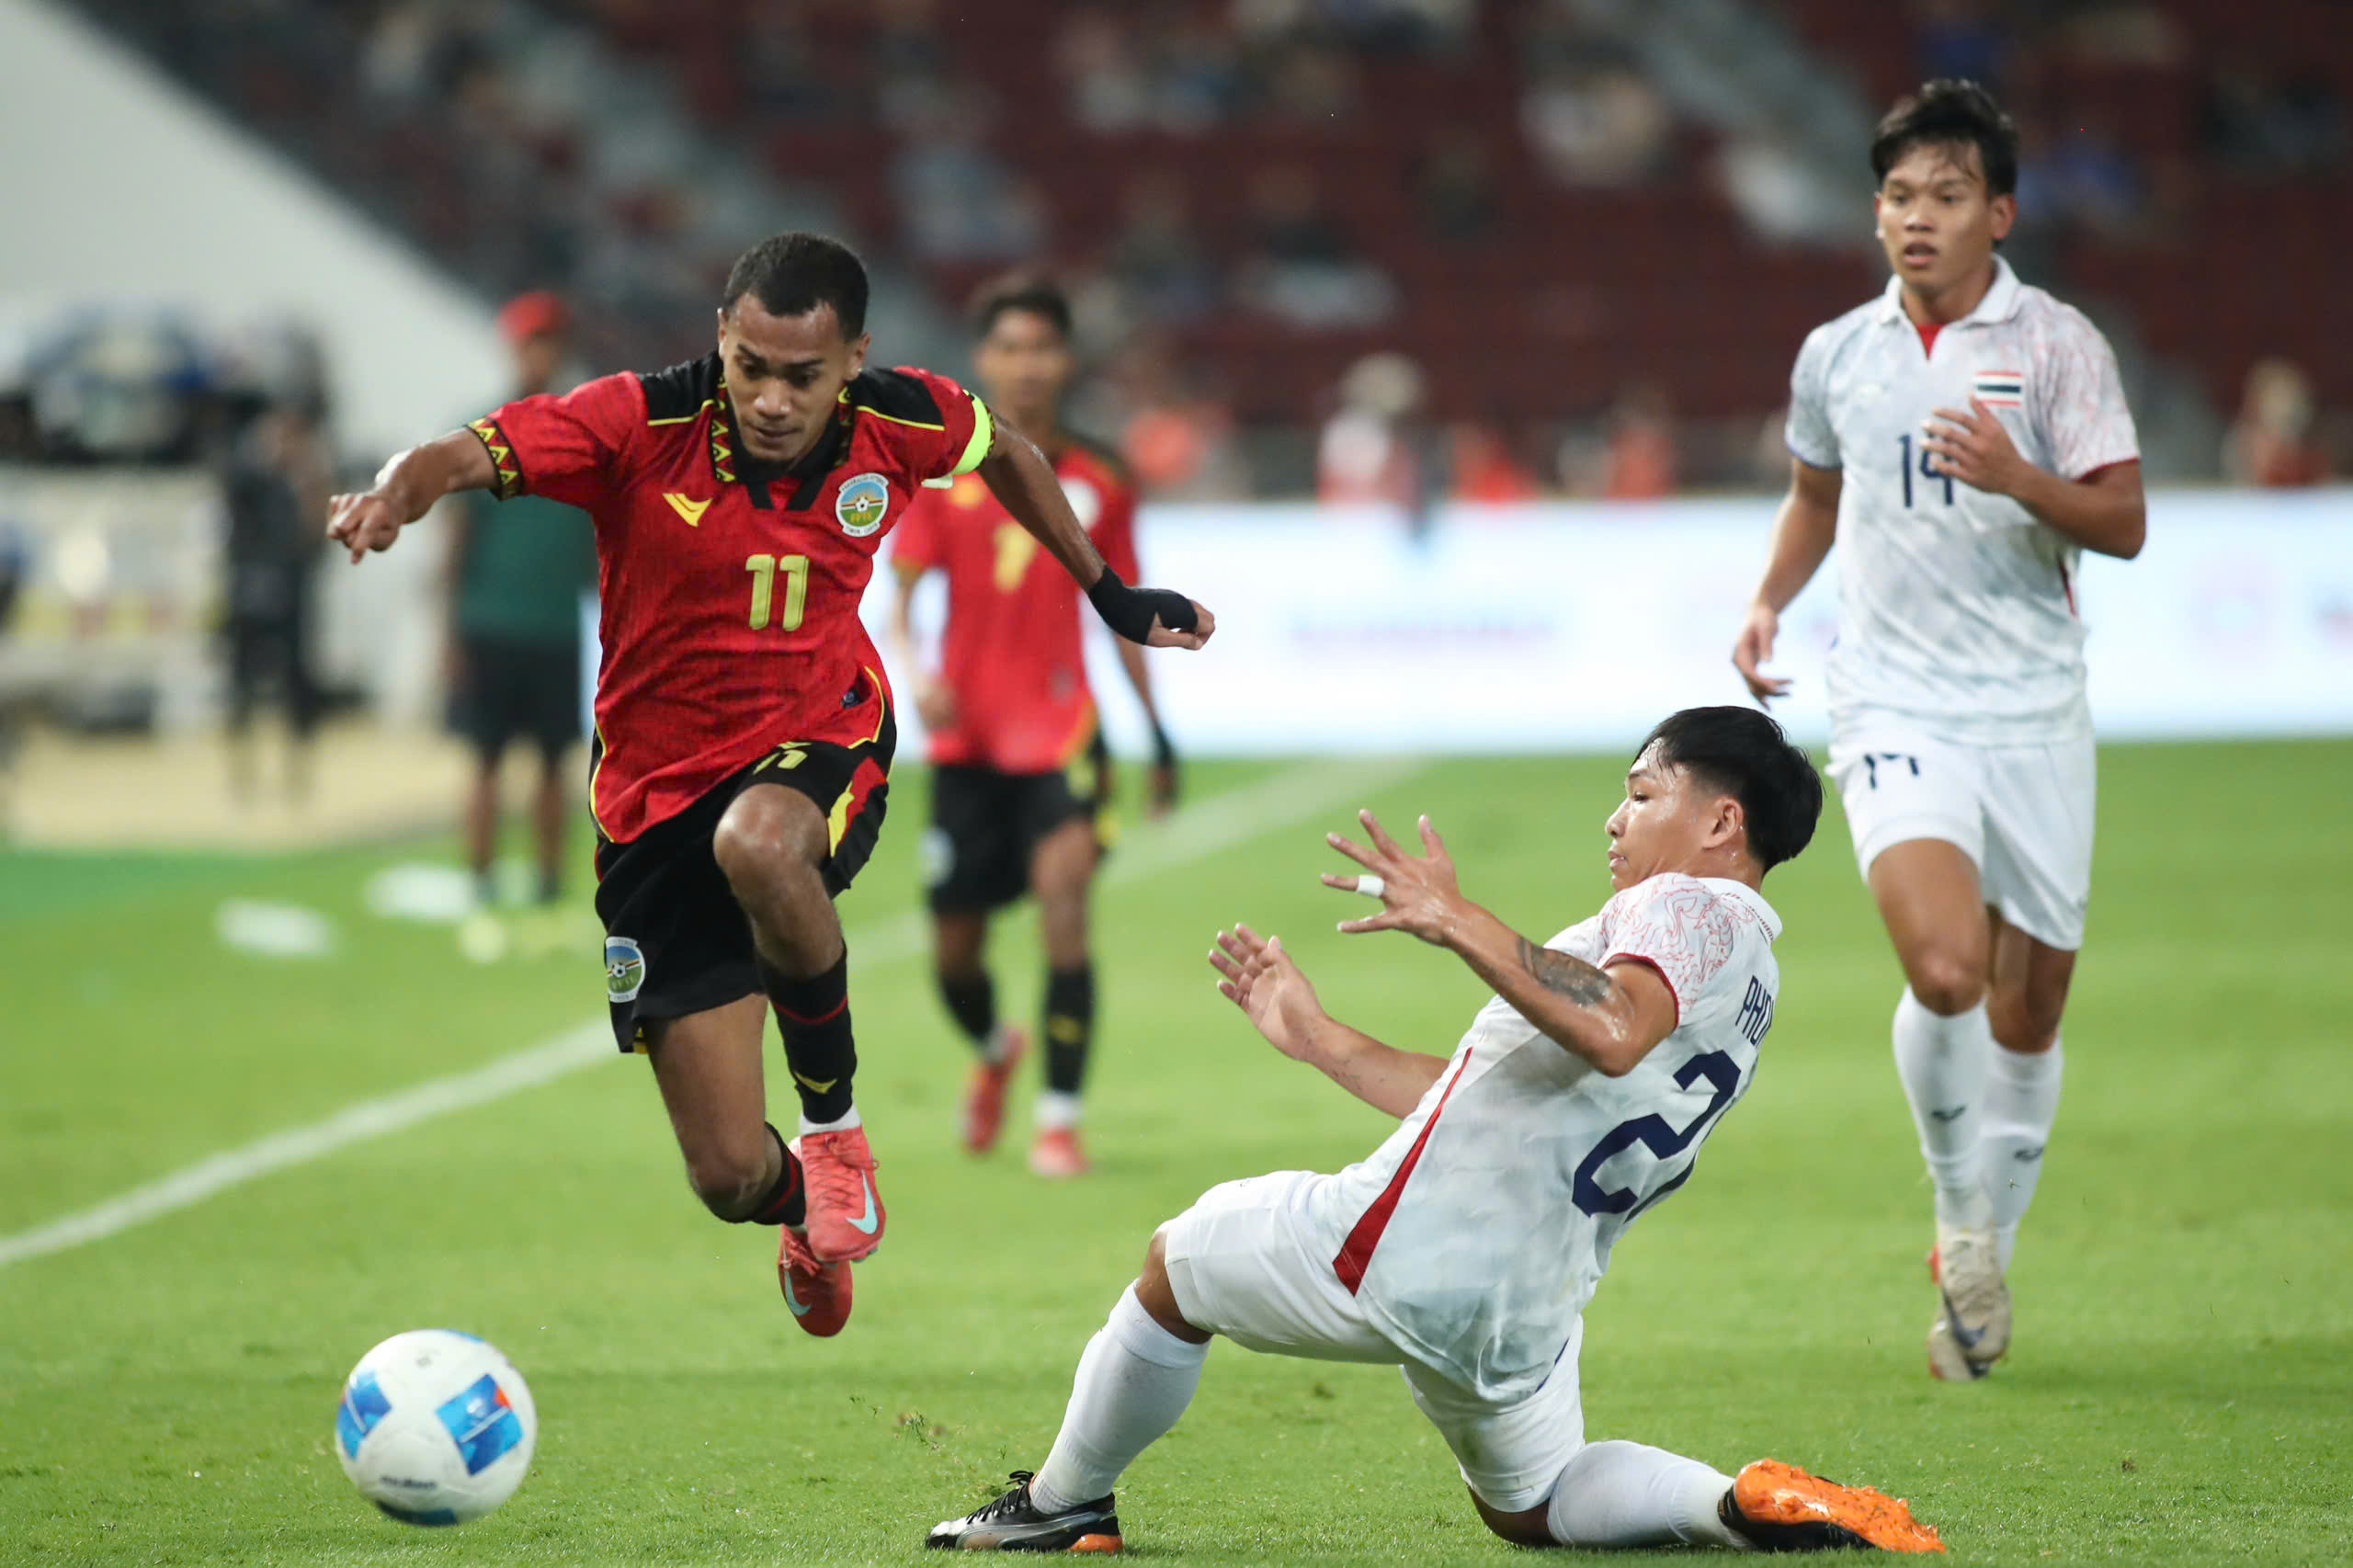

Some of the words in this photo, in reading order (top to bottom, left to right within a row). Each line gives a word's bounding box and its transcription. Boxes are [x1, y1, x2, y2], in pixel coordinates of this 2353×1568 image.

[745, 554, 809, 632] 11
[1734, 974, 1774, 1049] PHO
[1571, 1050, 1742, 1223] 2
